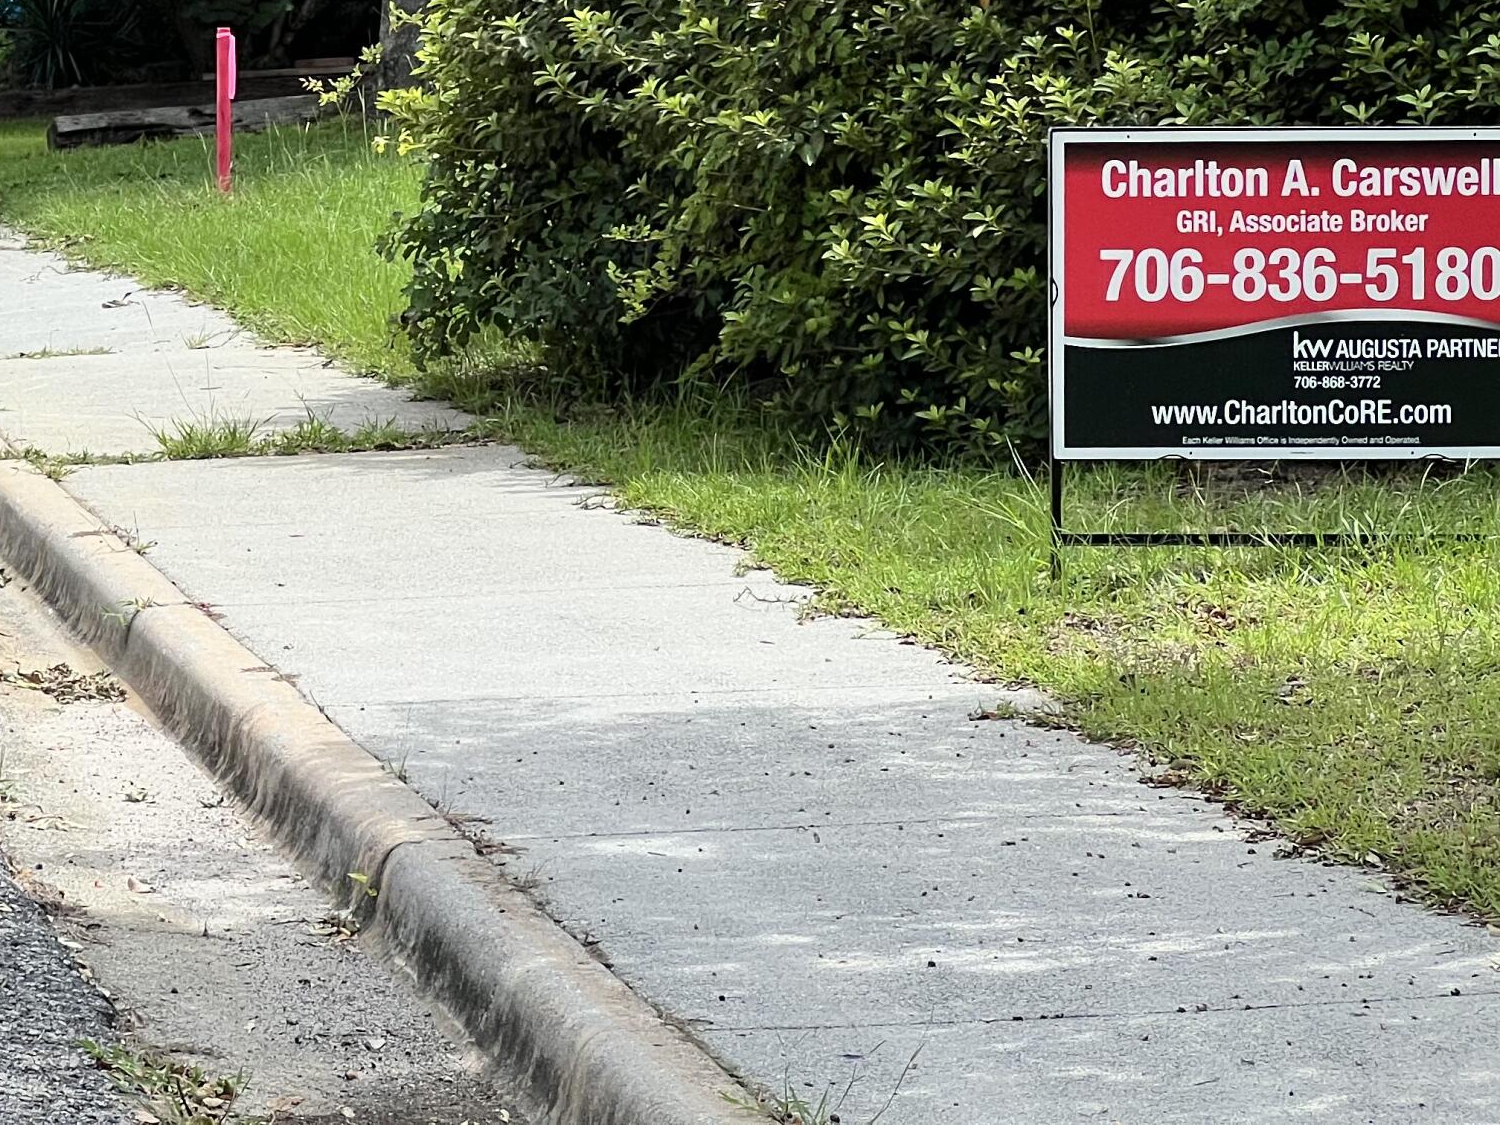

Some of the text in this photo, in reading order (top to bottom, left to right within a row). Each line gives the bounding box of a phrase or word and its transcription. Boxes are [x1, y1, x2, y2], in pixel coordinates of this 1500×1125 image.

[1100, 157, 1500, 199] Charlton A. Carswell
[1176, 209, 1429, 236] GRI, Associate Broker
[1099, 246, 1500, 303] 706-836-5180
[1292, 330, 1500, 359] kw AUGUSTA PARTNE
[1377, 360, 1415, 371] REALTY
[1293, 375, 1381, 389] 706-868-3772
[1151, 398, 1452, 425] www.CharltonCoRE.com
[1182, 436, 1201, 445] Each
[1256, 436, 1279, 445] Office
[1288, 436, 1339, 446] Independently
[1341, 435, 1368, 444] Owned
[1369, 436, 1384, 444] and
